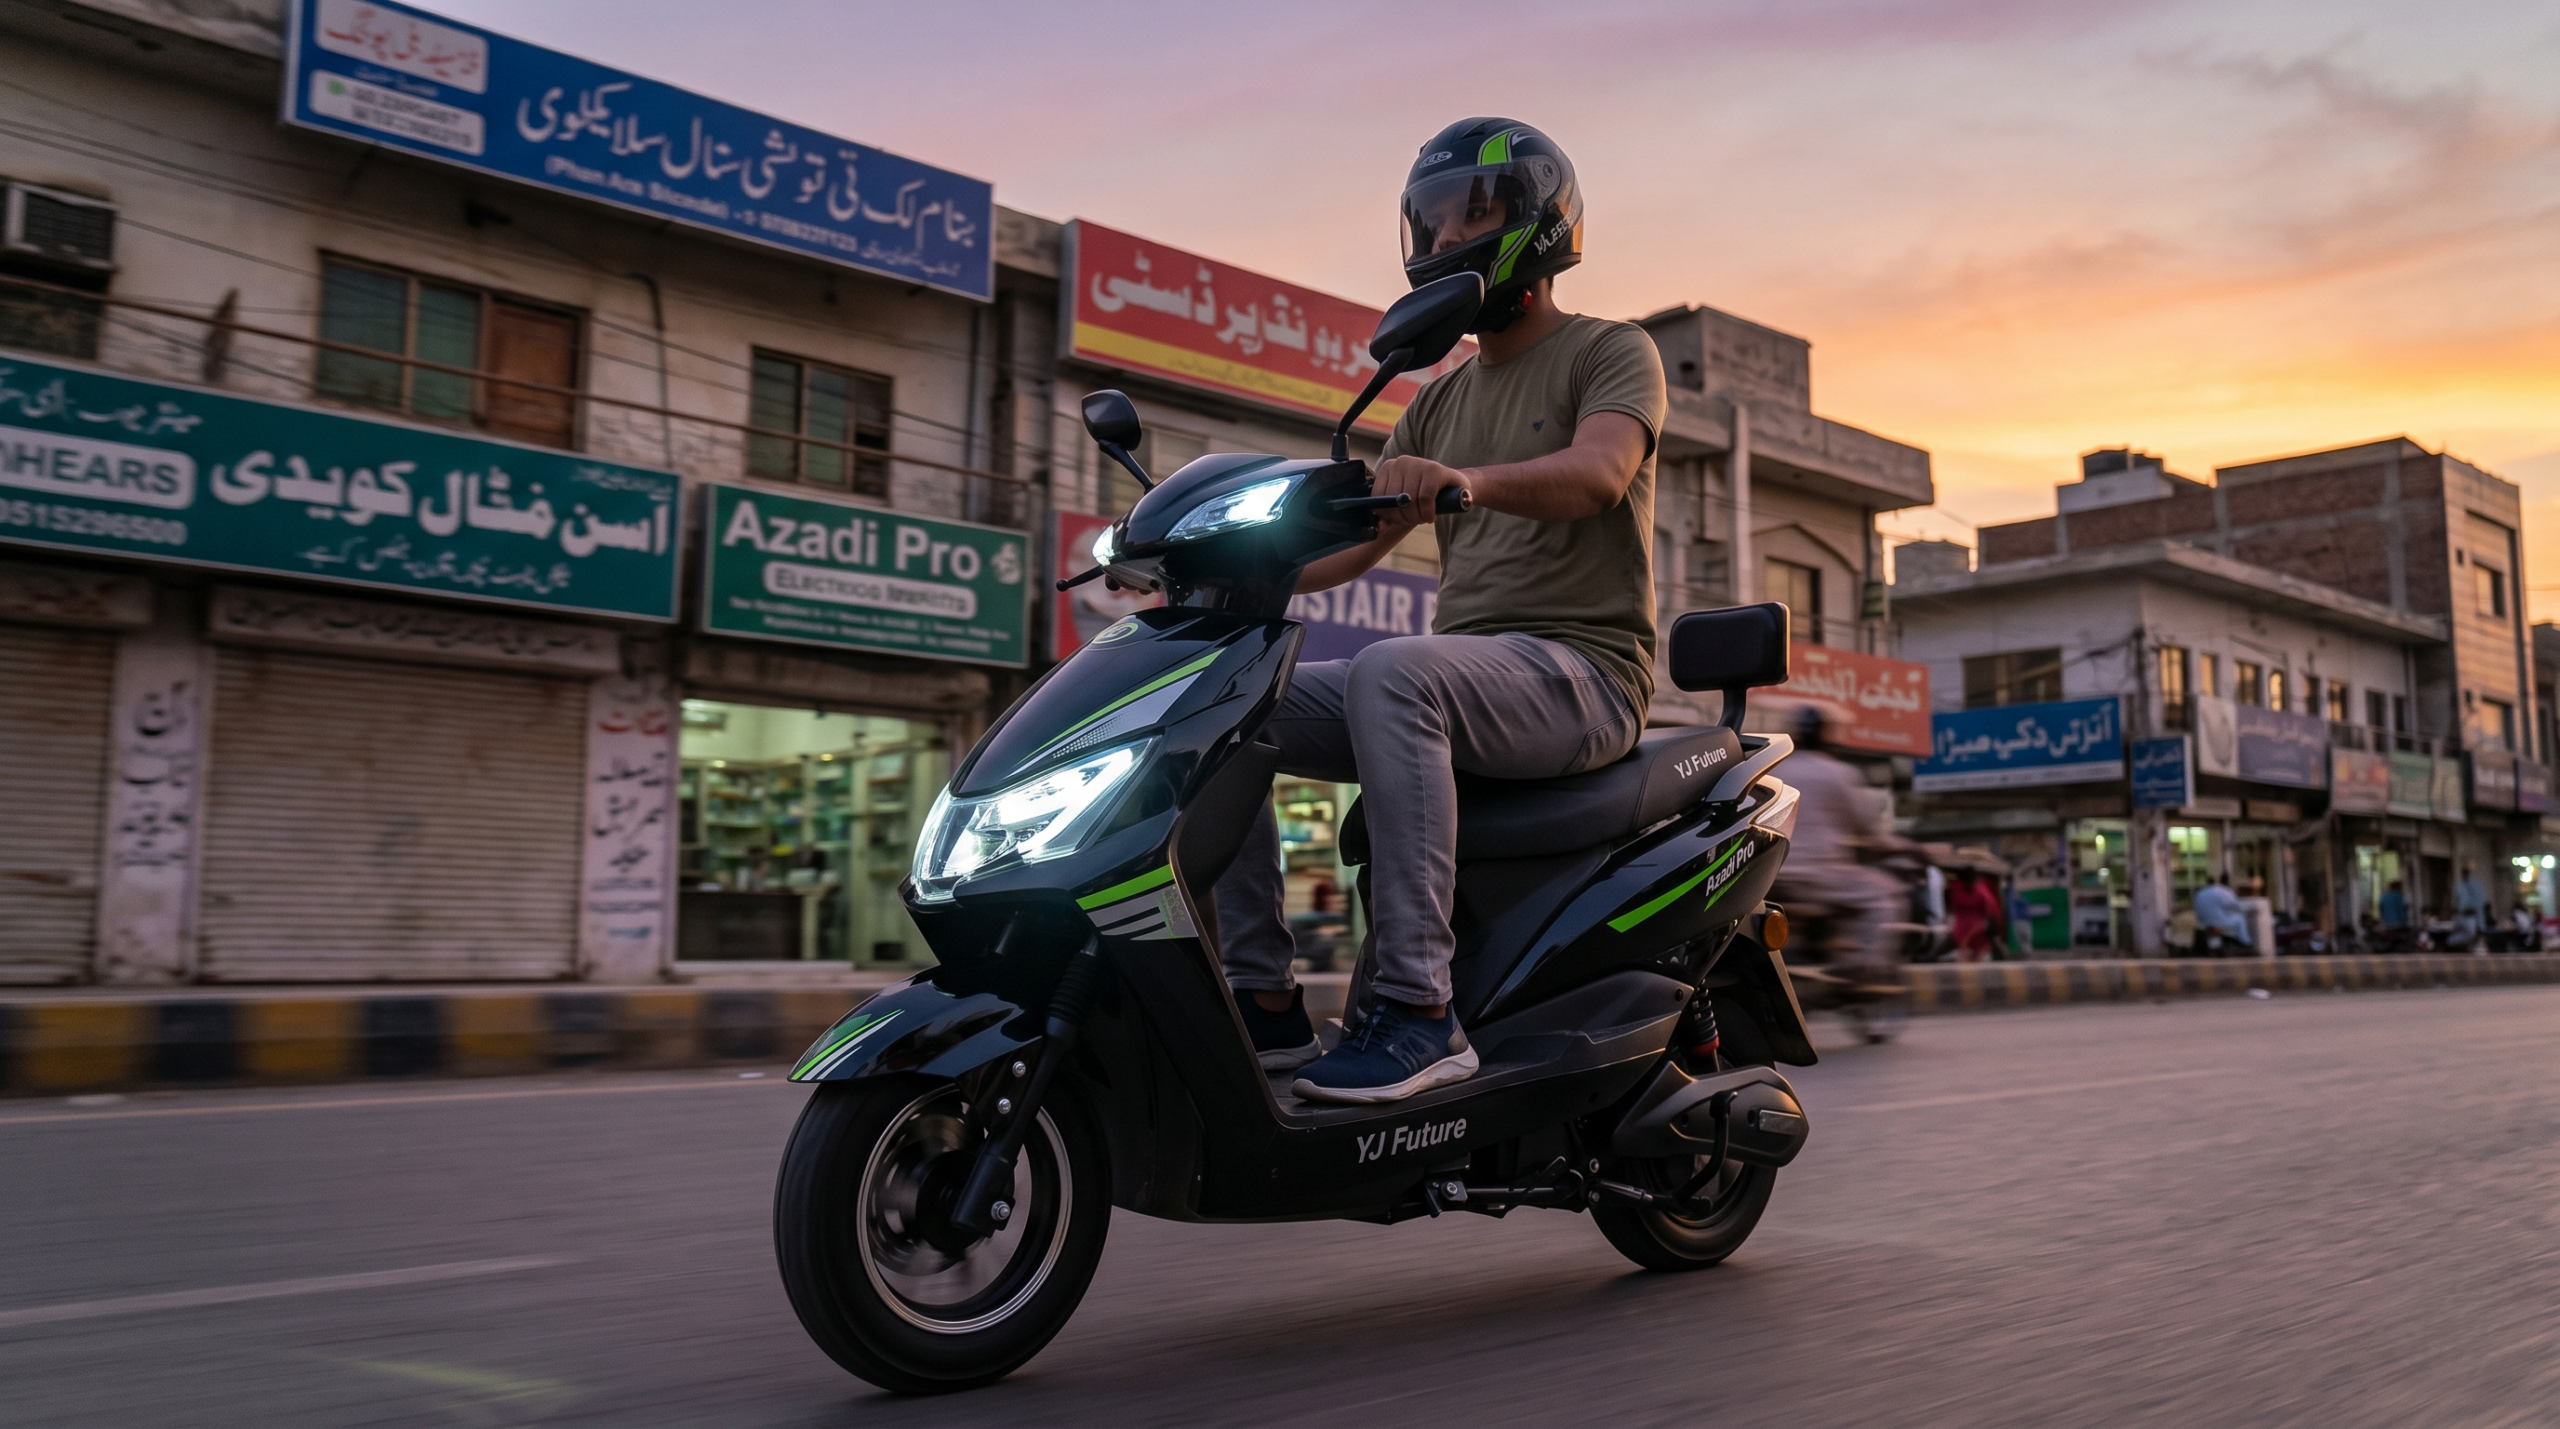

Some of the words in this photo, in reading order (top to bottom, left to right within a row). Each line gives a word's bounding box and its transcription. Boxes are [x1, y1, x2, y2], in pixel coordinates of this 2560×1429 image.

[721, 499, 879, 568] Azadi
[894, 524, 982, 581] Pro
[1284, 578, 1414, 636] STAIR
[1673, 759, 1693, 779] YJ
[1690, 747, 1728, 772] Future
[1705, 854, 1736, 897] Azadi
[1736, 840, 1755, 870] Pro
[1356, 1131, 1387, 1164] YJ
[1390, 1117, 1467, 1156] Future
